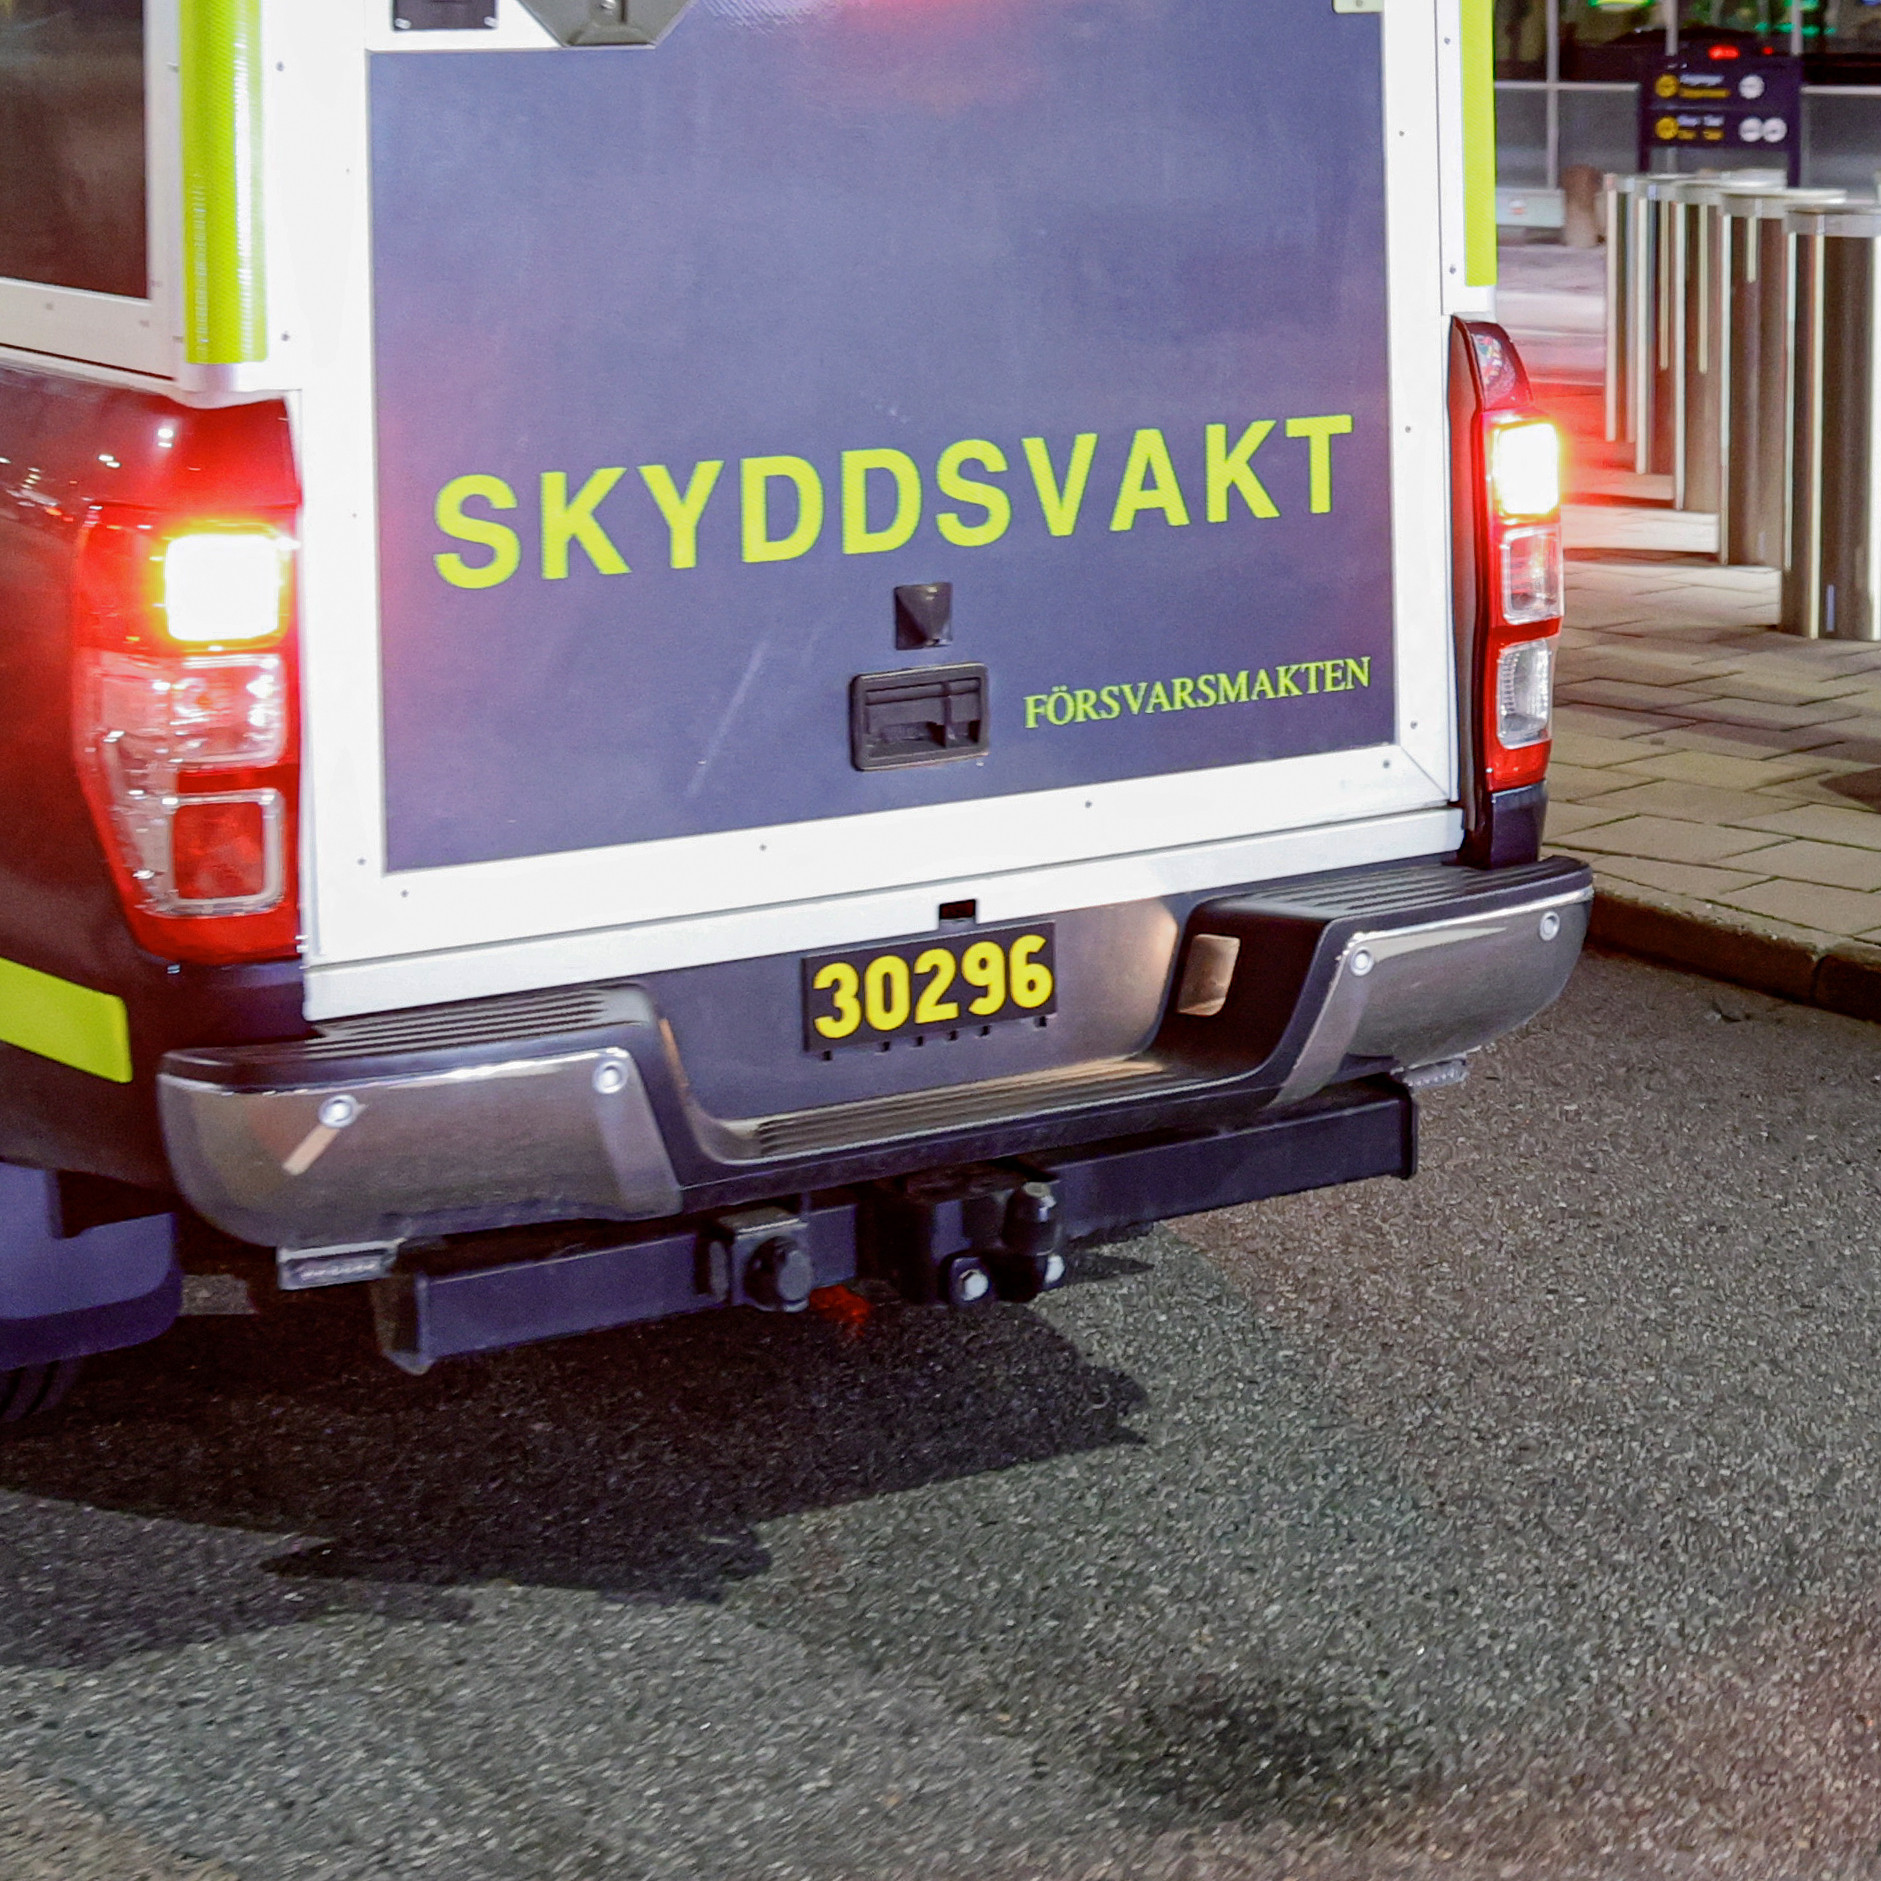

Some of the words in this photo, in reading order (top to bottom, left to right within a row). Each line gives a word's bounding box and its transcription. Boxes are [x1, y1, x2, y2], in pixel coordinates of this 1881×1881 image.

[432, 414, 1353, 590] SKYDDSVAKT
[1023, 655, 1372, 729] FÖRSVARSMAKTEN
[812, 934, 1054, 1039] 30296
